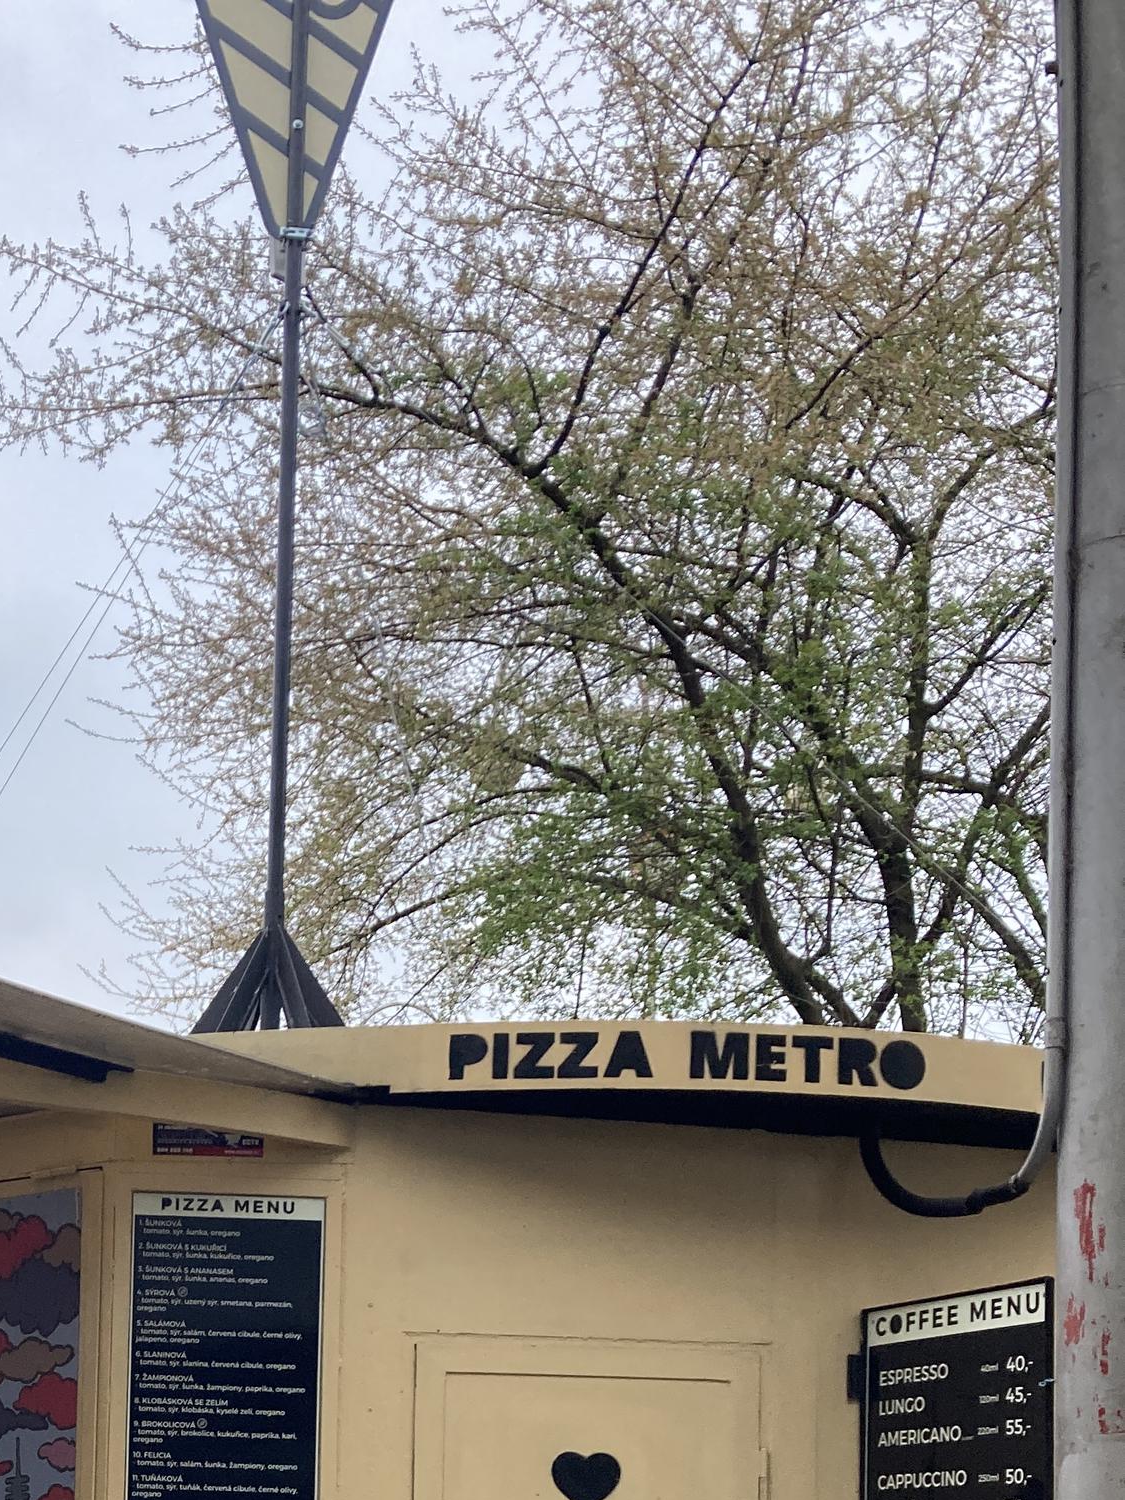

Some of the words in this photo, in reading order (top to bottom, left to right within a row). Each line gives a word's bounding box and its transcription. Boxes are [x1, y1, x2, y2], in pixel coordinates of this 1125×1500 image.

[448, 1030, 653, 1079] PIZZA
[689, 1030, 926, 1089] METRO
[161, 1197, 224, 1212] PIZZA
[234, 1200, 295, 1214] MENU
[145, 1219, 182, 1227] ŠUNKOVÁ
[146, 1242, 183, 1250] ŠUNKOVÁ
[146, 1265, 182, 1273] ŠUNKOVÁ
[190, 1267, 234, 1275] ANANASEM
[145, 1288, 175, 1296] SÝROVÁ
[876, 1305, 958, 1336] COFFEE
[971, 1291, 1040, 1322] MENU
[880, 1364, 949, 1386] ESPRESSO
[1006, 1355, 1033, 1373] 40,-
[142, 1373, 194, 1381] ŽAMPIONOVÁ
[142, 1397, 193, 1405] KLOBÁSKOVÁ
[879, 1397, 925, 1416] LUNGO
[1005, 1387, 1032, 1404] 45,-
[141, 1420, 195, 1428] BROKOLICOVÁ
[878, 1426, 962, 1447] AMERICANO
[1005, 1419, 1031, 1436] 55,-
[141, 1474, 183, 1482] TUŇÁKOVÁ
[878, 1470, 967, 1490] CAPPUCCINO
[1005, 1469, 1032, 1485] 50,-
